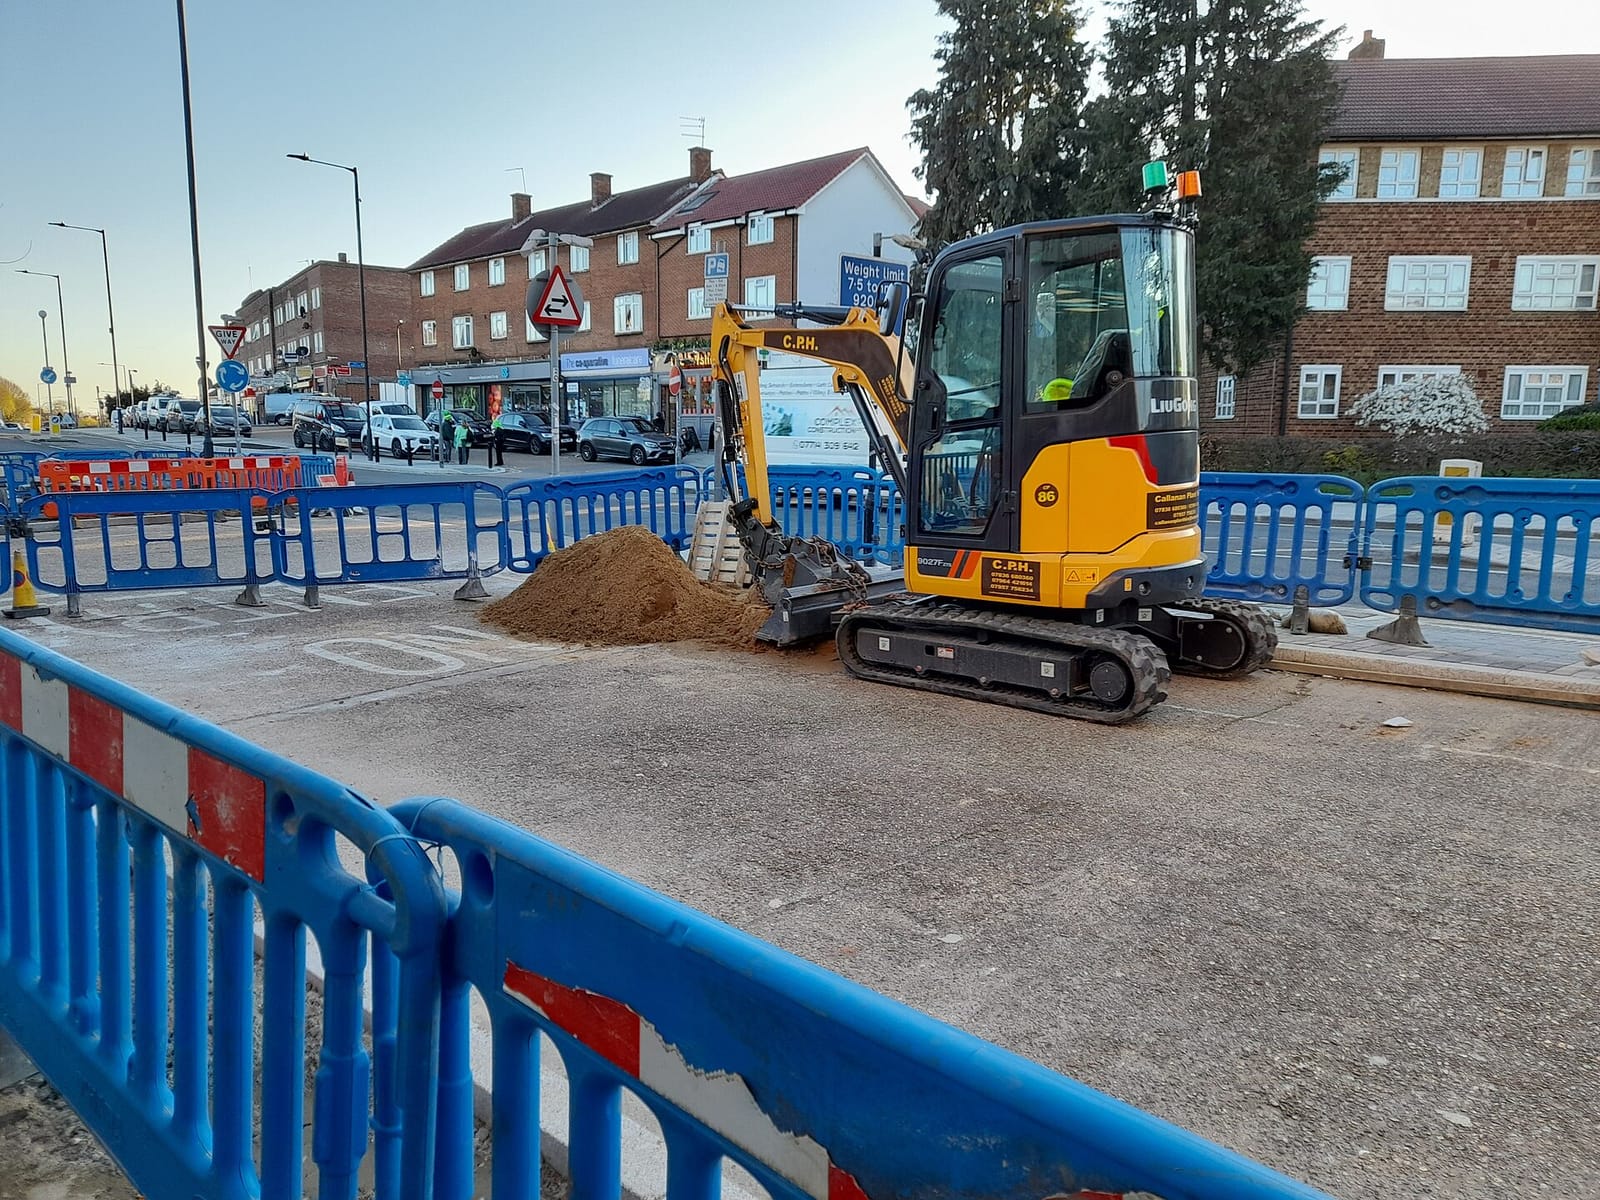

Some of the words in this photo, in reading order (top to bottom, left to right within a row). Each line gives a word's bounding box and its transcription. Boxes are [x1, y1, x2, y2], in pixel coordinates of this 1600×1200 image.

[707, 257, 717, 275] P
[844, 261, 880, 279] Weight
[883, 267, 905, 281] limit
[853, 293, 874, 307] 920
[215, 330, 238, 338] GIVE
[783, 334, 819, 351] C.P.H.
[1037, 490, 1056, 502] 86
[992, 559, 1033, 573] C.P.H.
